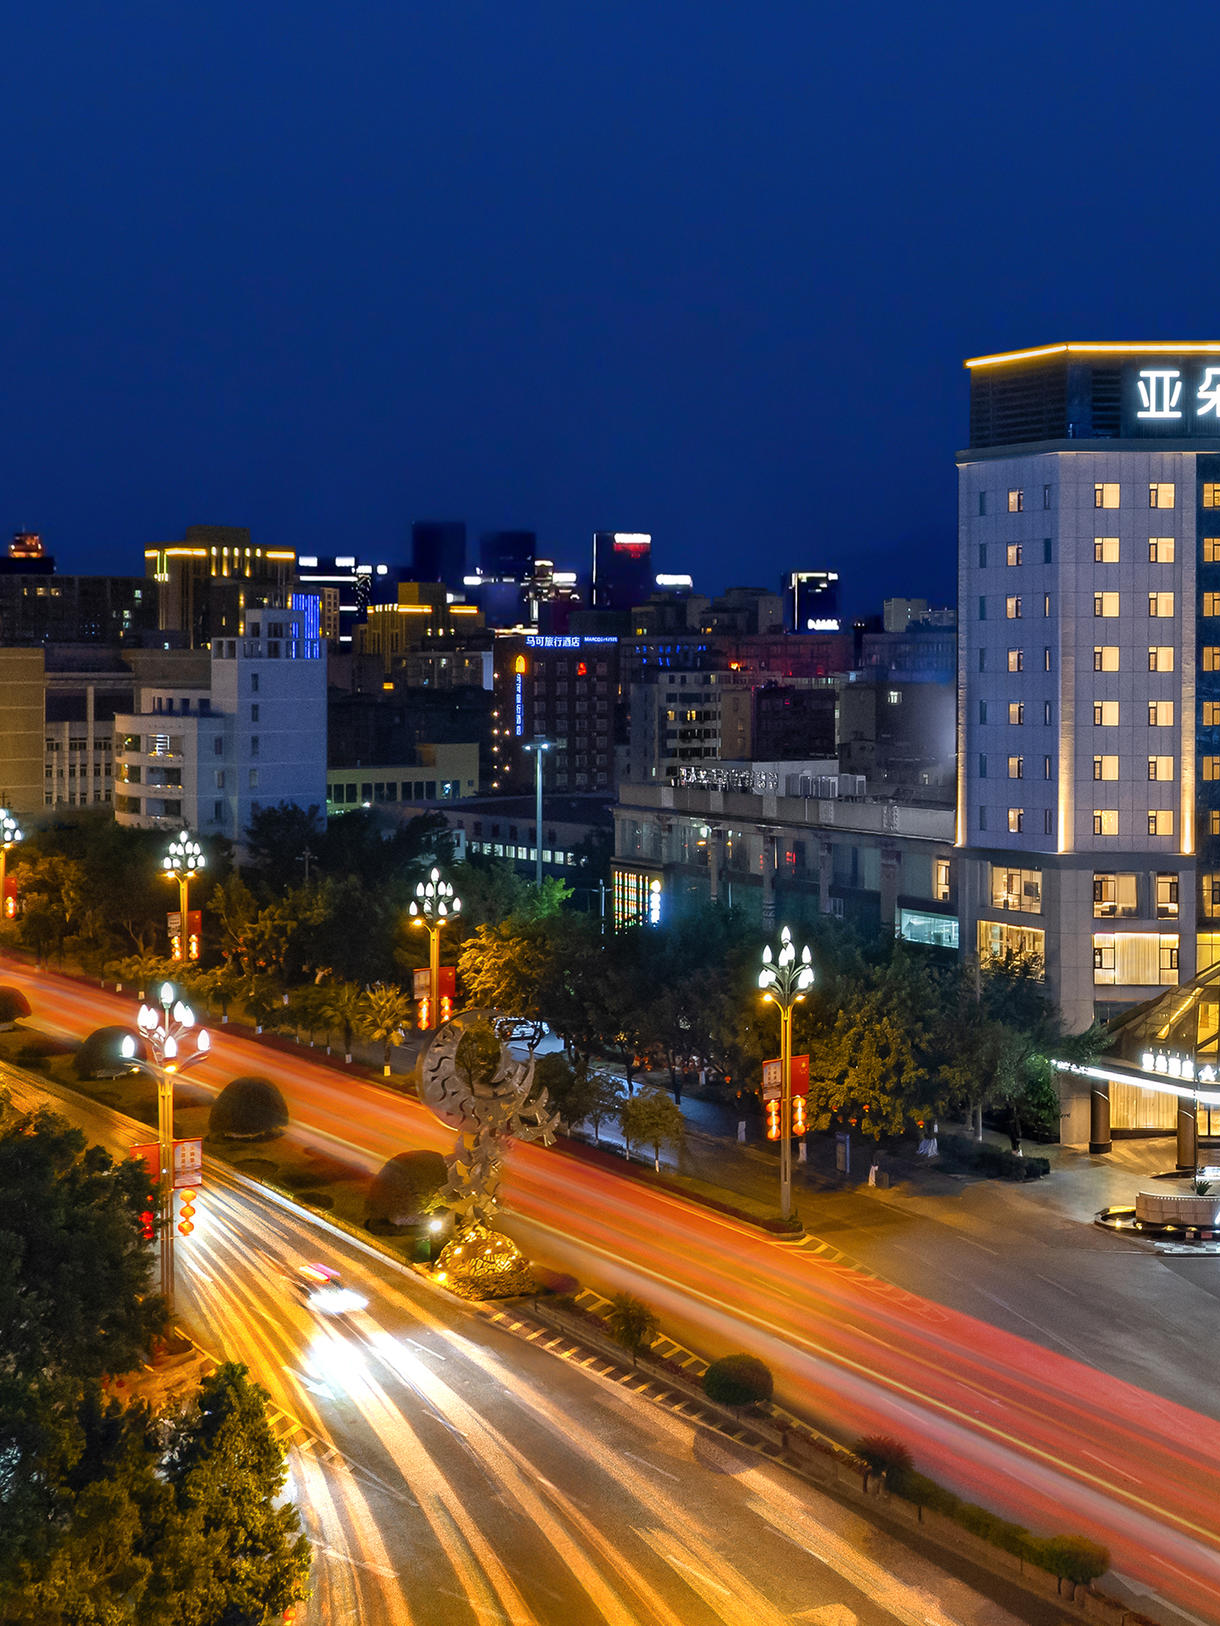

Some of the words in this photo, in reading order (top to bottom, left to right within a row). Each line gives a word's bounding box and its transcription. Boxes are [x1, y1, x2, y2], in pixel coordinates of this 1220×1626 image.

[526, 636, 580, 647] 马可旅行酒店
